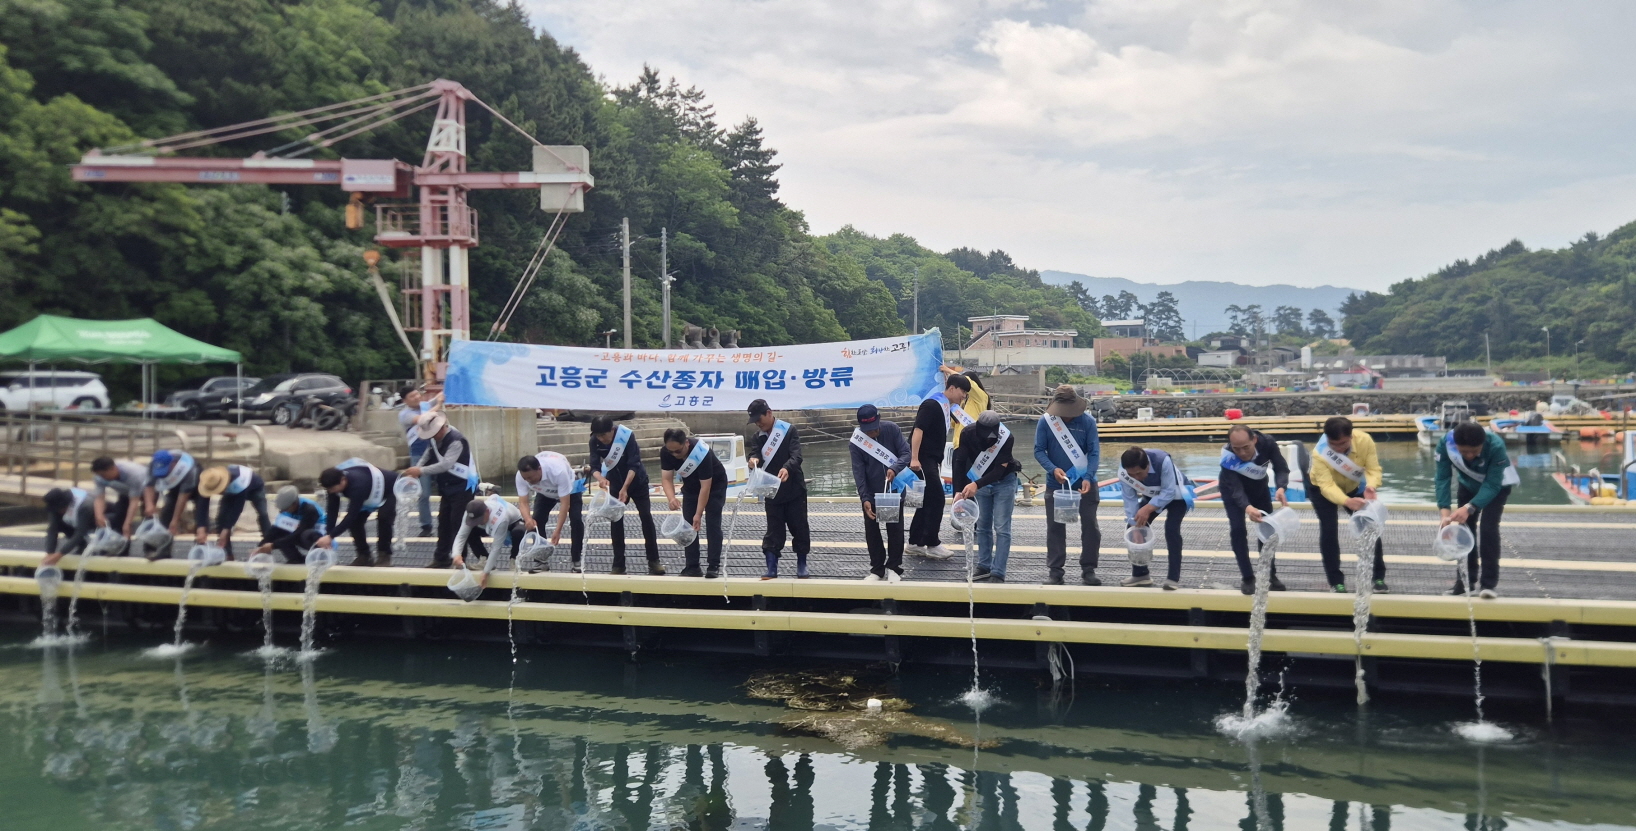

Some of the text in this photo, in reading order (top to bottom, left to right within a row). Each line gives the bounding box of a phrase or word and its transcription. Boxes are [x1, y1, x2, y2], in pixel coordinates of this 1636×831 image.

[693, 353, 726, 363] 가꾸는
[731, 352, 763, 363] 생명의
[535, 365, 608, 389] 고흥군
[618, 369, 725, 390] 수산종자
[674, 395, 714, 407] 고흥군
